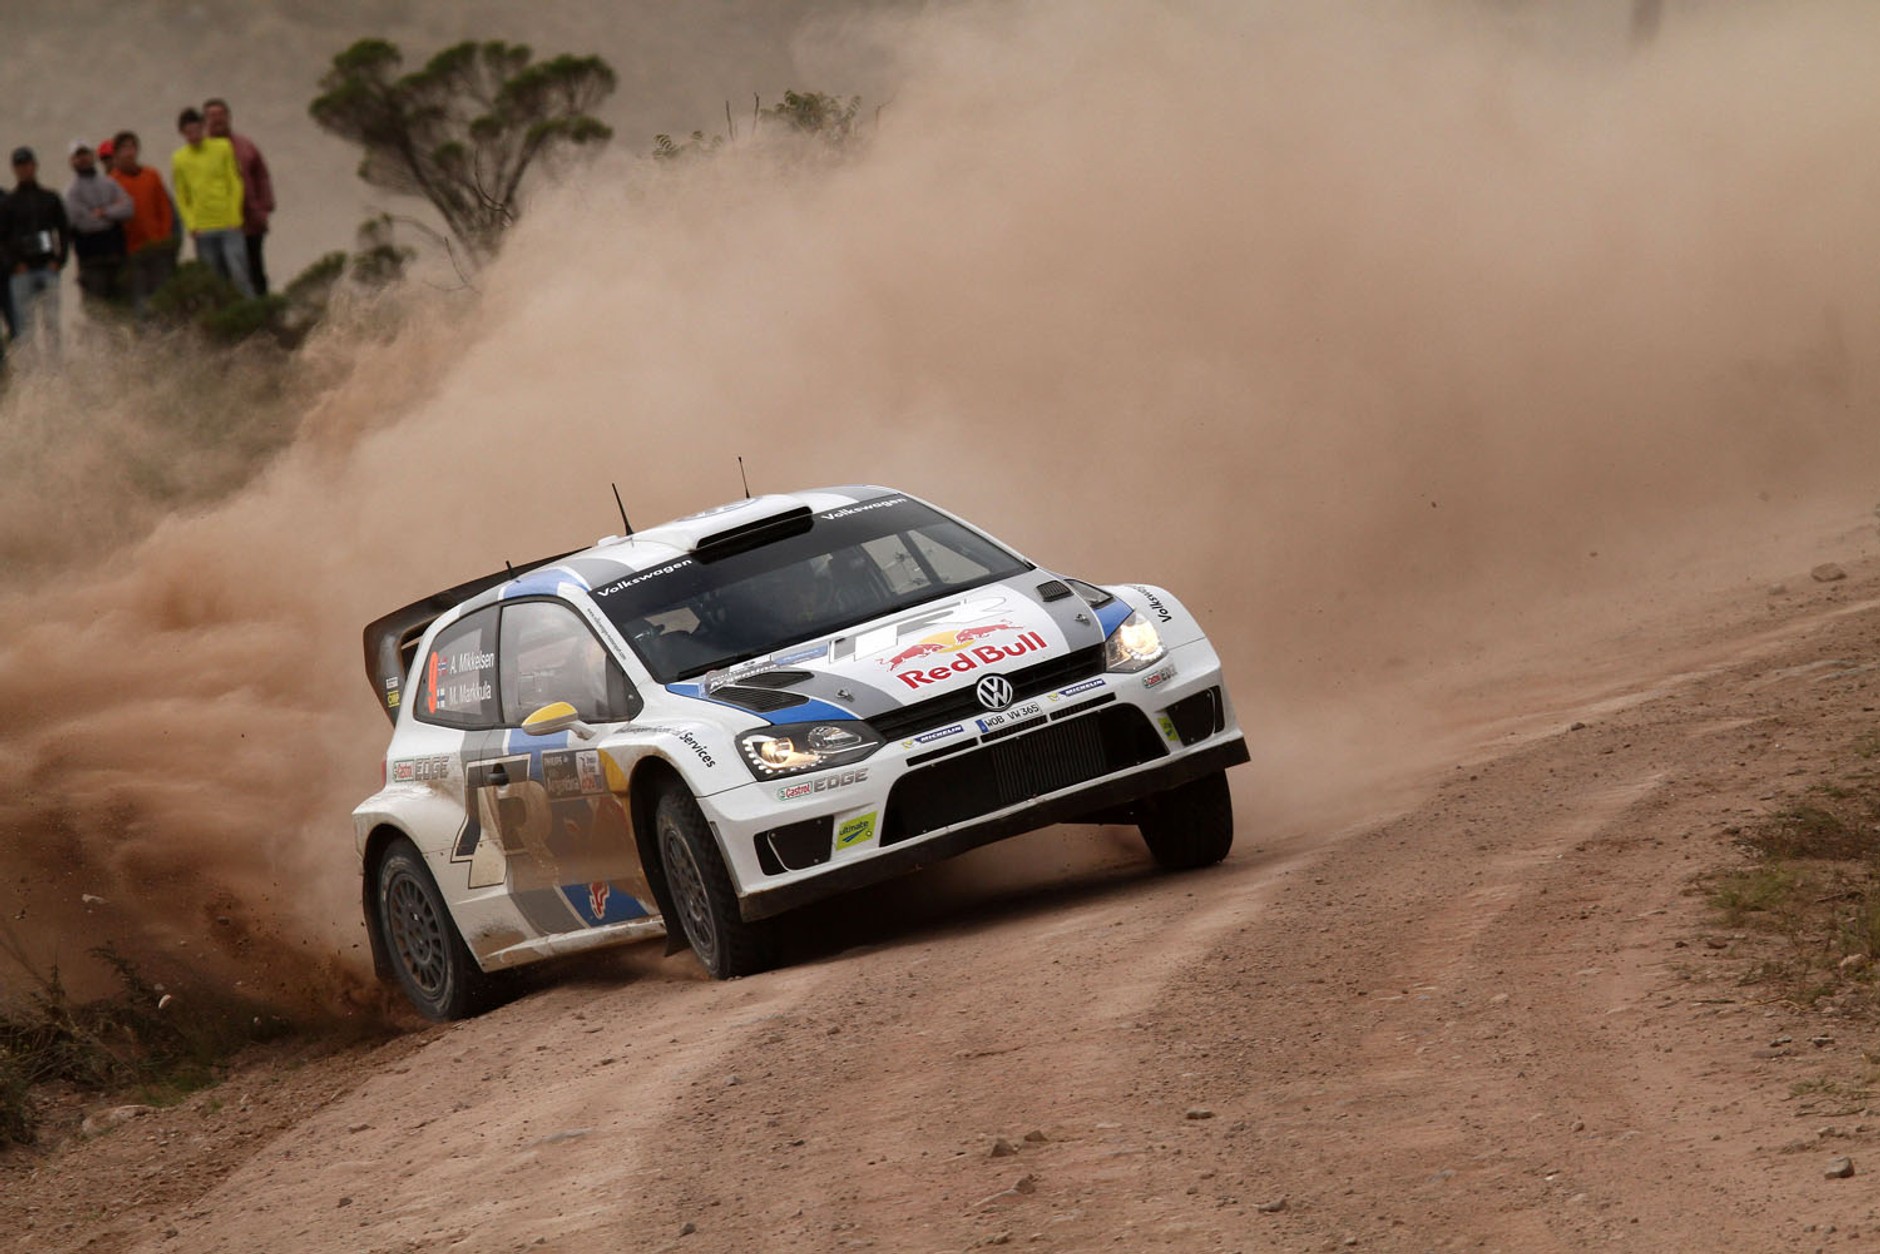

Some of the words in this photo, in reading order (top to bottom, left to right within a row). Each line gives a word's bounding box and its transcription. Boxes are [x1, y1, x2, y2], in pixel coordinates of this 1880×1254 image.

[821, 498, 907, 520] Volkswagen
[597, 559, 693, 597] Volkswagen
[458, 650, 495, 672] Mikkelsen
[896, 652, 979, 690] Red
[970, 631, 1048, 665] Bull
[427, 651, 439, 714] 9
[460, 681, 492, 703] Markkula
[1065, 679, 1103, 695] MICHELIN
[985, 715, 1005, 727] WOB
[1007, 710, 1021, 720] VW
[1020, 704, 1039, 716] 365
[920, 726, 961, 742] MICHELIN
[679, 731, 716, 768] Services
[785, 783, 811, 798] Castrol
[813, 767, 869, 793] EDGE
[839, 821, 870, 836] ultimate
